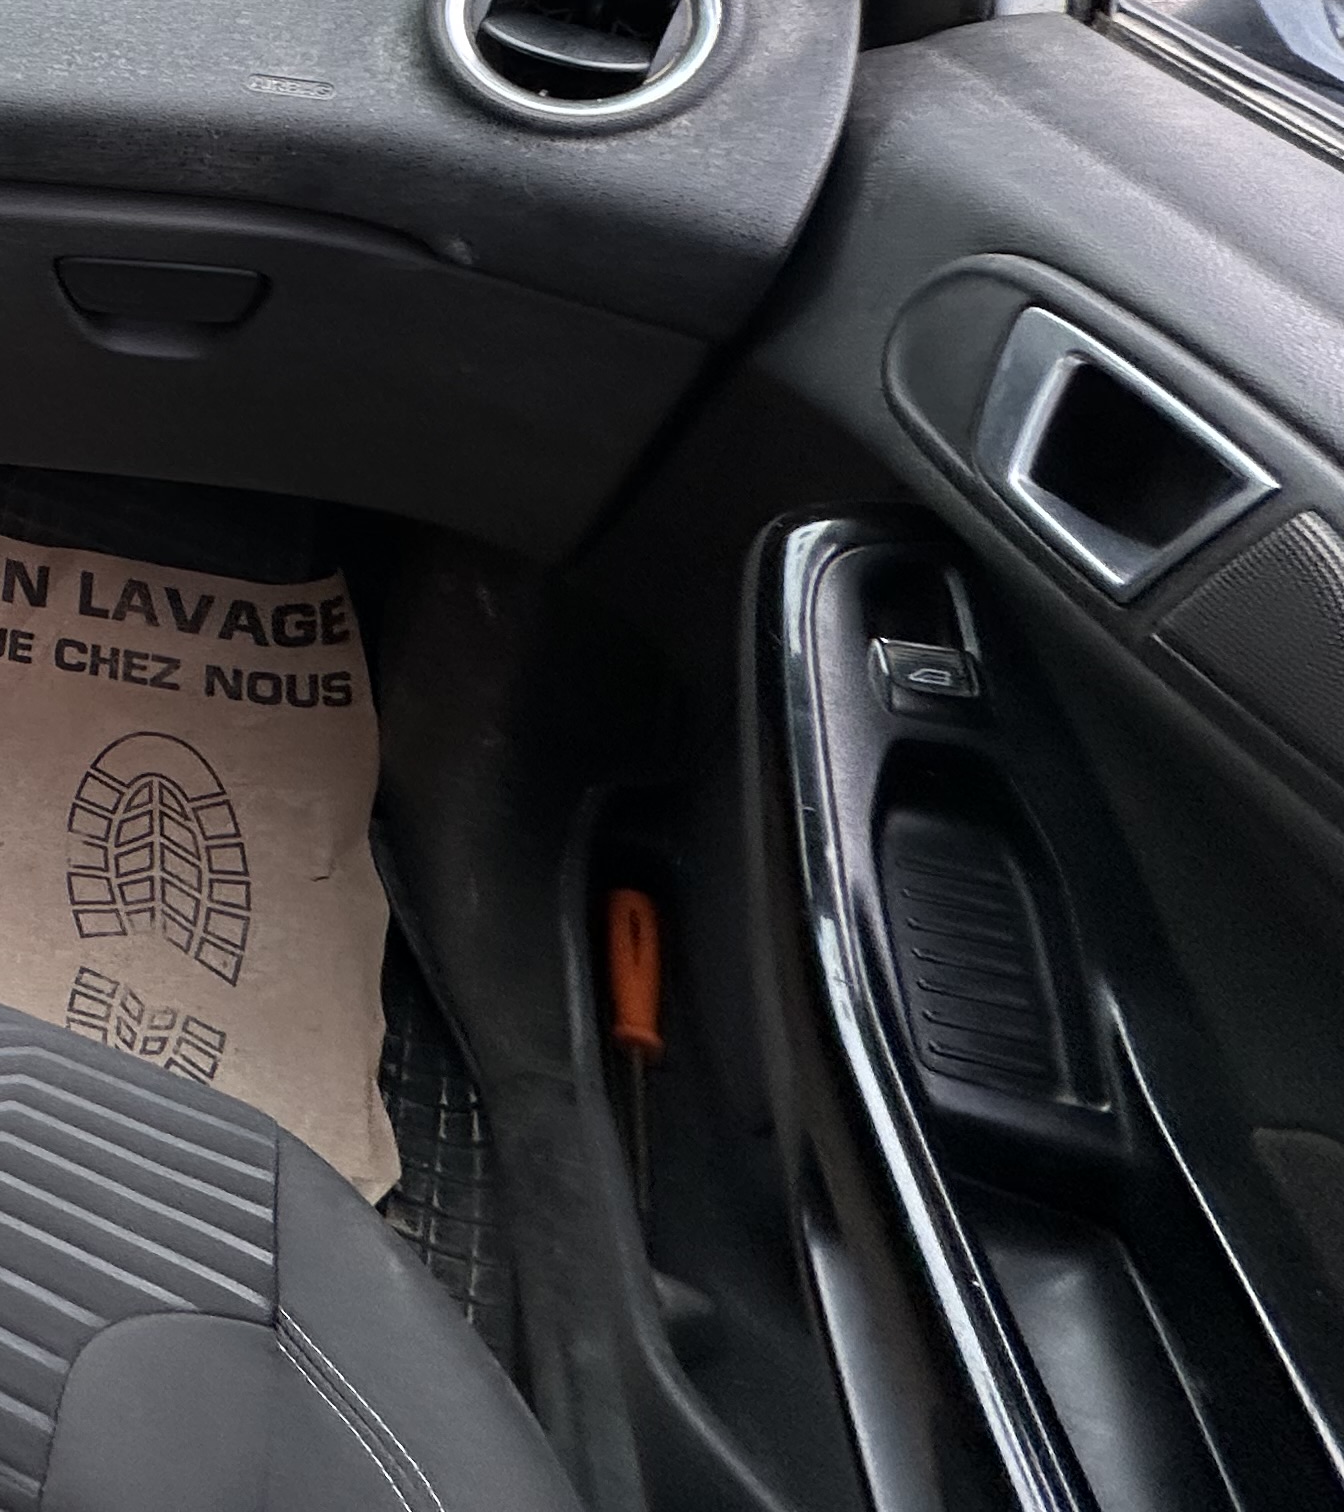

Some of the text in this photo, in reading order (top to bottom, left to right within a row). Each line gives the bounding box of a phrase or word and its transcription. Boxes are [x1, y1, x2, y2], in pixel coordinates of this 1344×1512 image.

[77, 570, 351, 648] LAVAGE
[52, 638, 182, 692] CHEZ
[203, 665, 353, 708] NOUS
